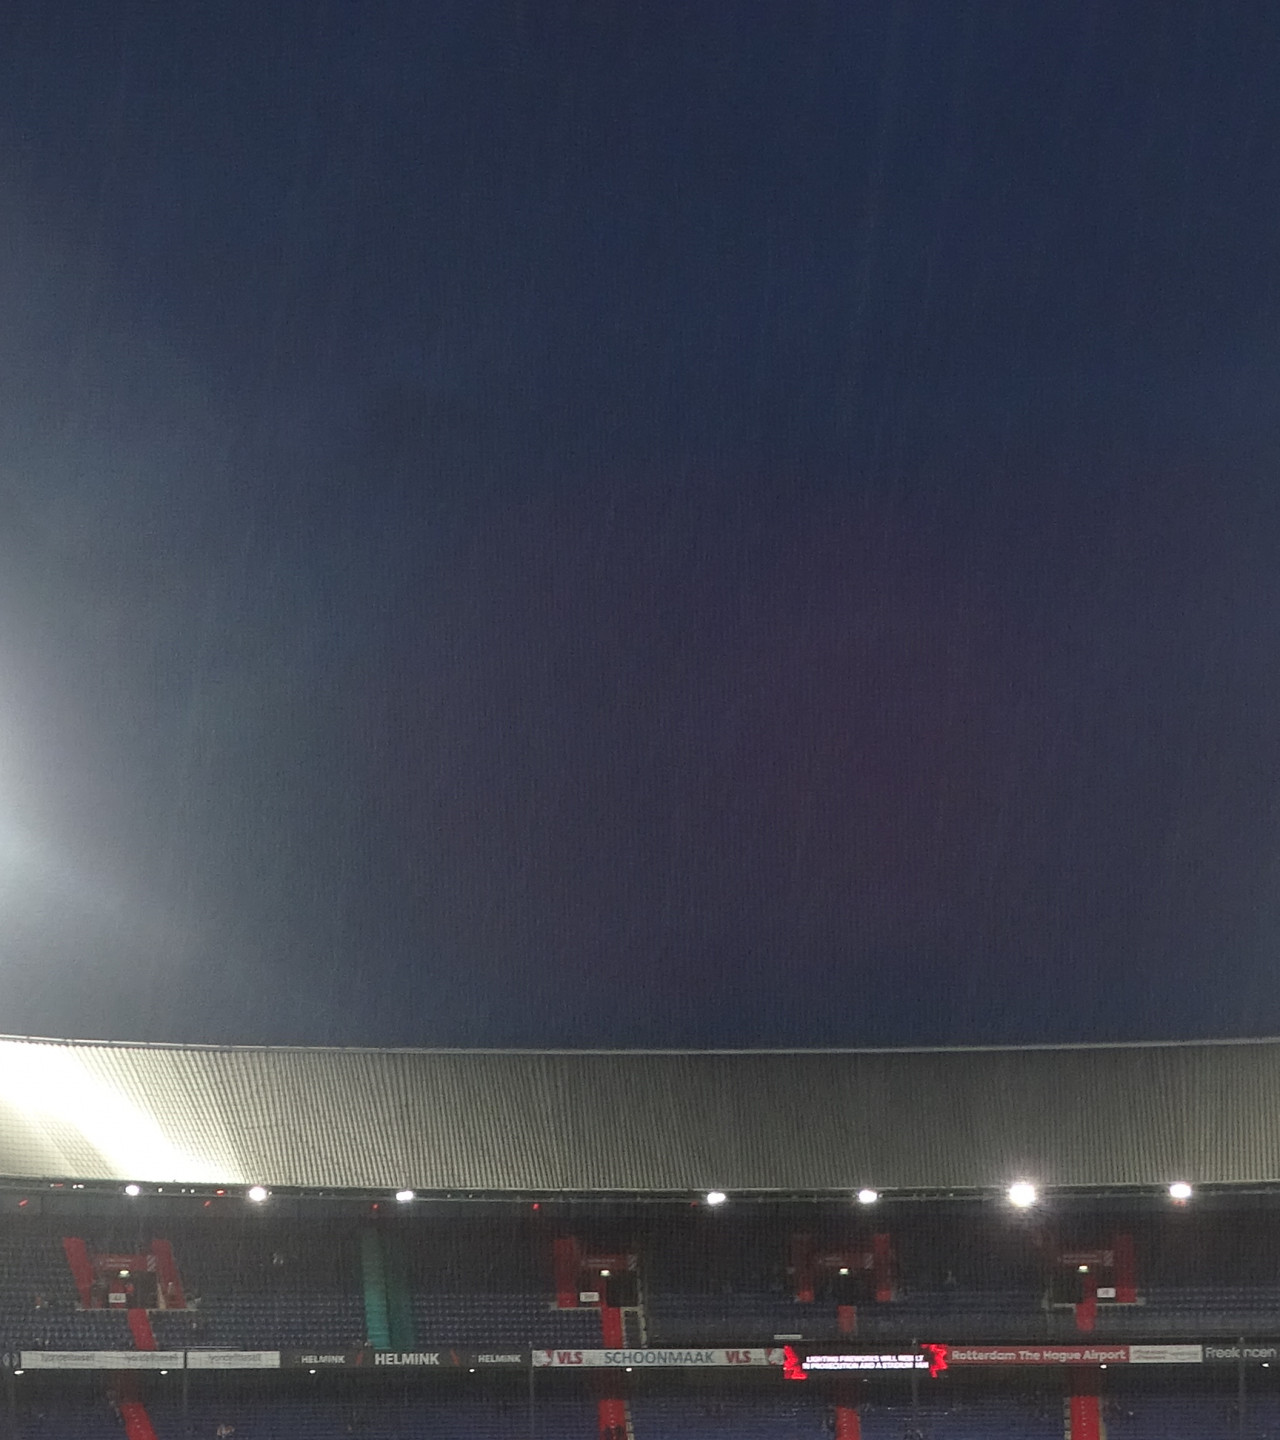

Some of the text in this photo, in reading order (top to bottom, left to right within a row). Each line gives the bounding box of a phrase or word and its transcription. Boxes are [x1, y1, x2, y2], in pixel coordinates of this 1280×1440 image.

[302, 1355, 345, 1364] HELMINK
[375, 1353, 439, 1365] HELMINK
[478, 1355, 521, 1363] HELMINK
[557, 1351, 751, 1364] VLS SCHOONMAAK VLS
[951, 1350, 1016, 1362] Rotterdam
[1018, 1350, 1040, 1361] The
[1043, 1350, 1081, 1363] Hague
[1083, 1349, 1126, 1362] Airport
